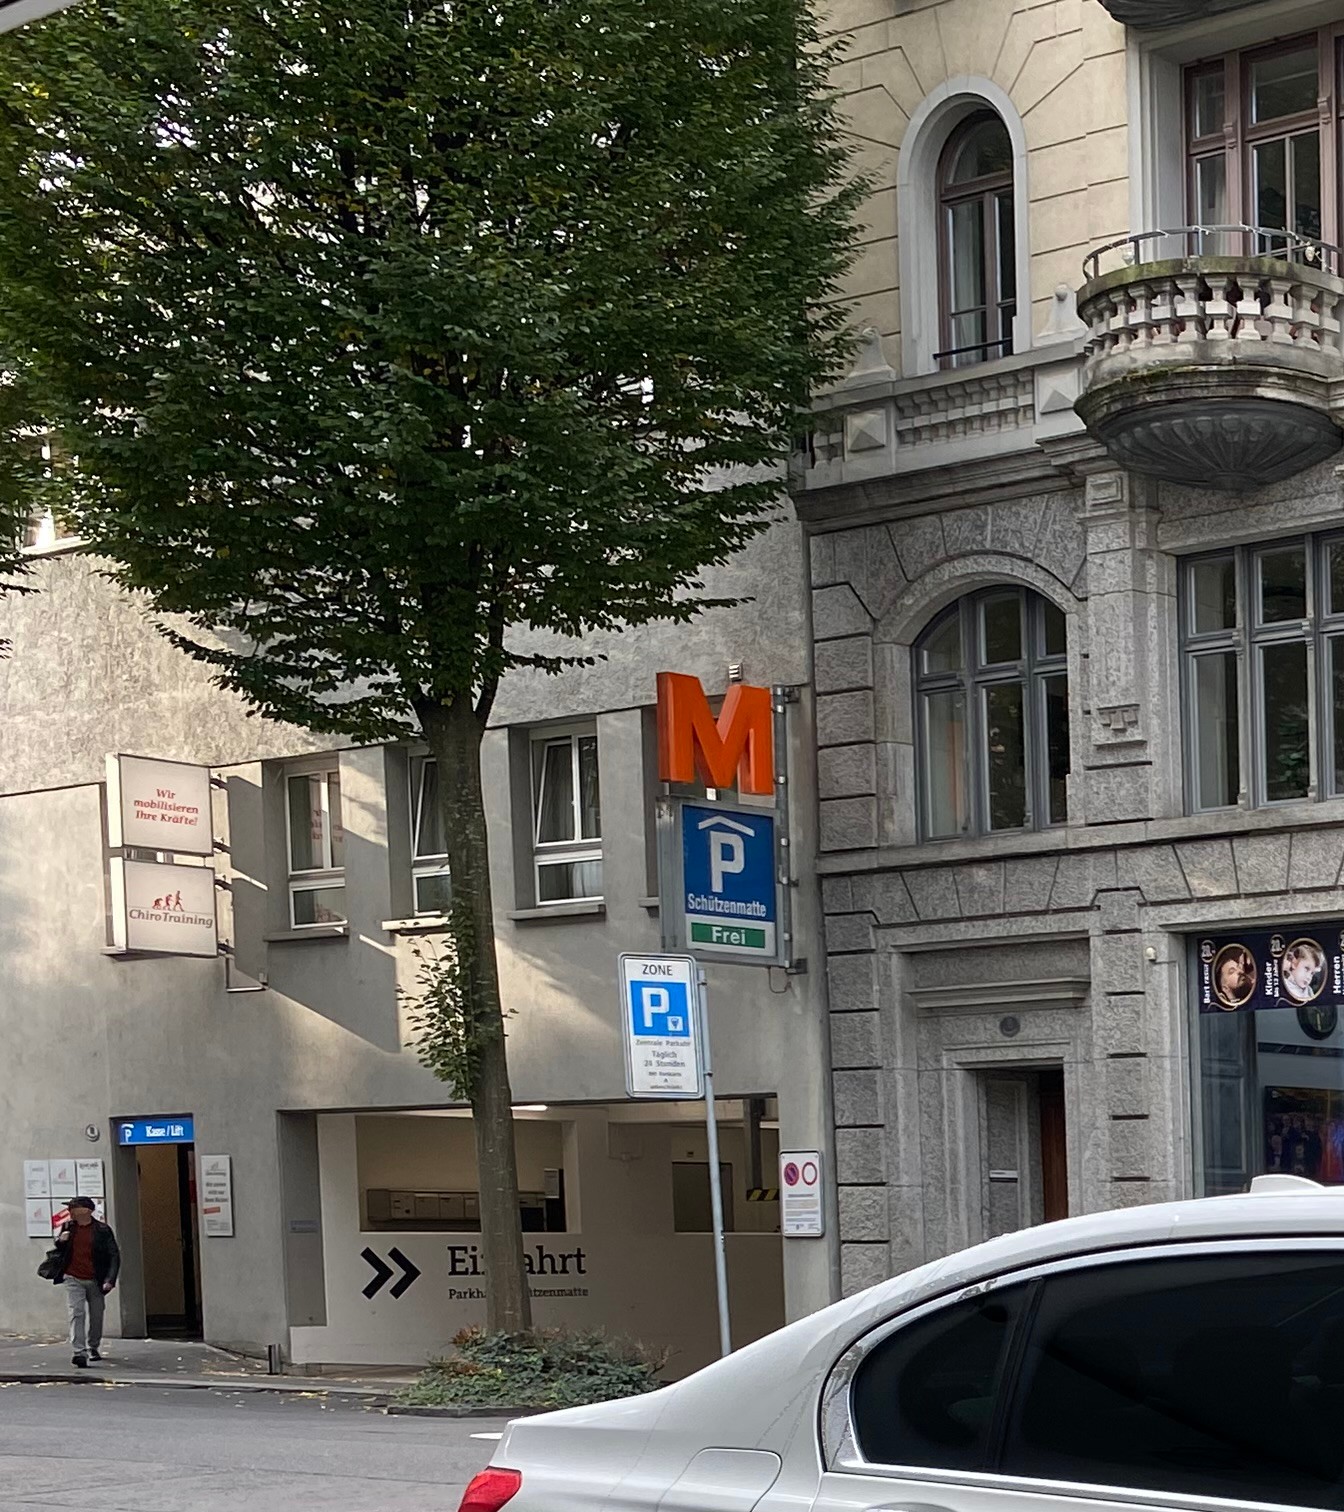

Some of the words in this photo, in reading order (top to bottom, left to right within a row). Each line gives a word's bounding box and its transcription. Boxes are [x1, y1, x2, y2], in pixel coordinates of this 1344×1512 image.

[656, 671, 774, 795] M
[156, 788, 176, 800] Wir
[133, 799, 199, 815] mobilisieren
[135, 809, 157, 821] Ihre
[160, 813, 198, 826] Kräfte!
[710, 830, 745, 893] P
[687, 893, 767, 918] Schützenmatte
[129, 908, 213, 928] ChiroTraining
[711, 926, 746, 945] Frei
[641, 963, 673, 976] ZONE
[1264, 961, 1273, 996] Kinder
[1333, 955, 1342, 994] Herren
[641, 986, 670, 1028] P
[170, 1124, 185, 1137] Lift
[447, 1245, 587, 1276] Eiahrt
[448, 1288, 487, 1300] Parkh
